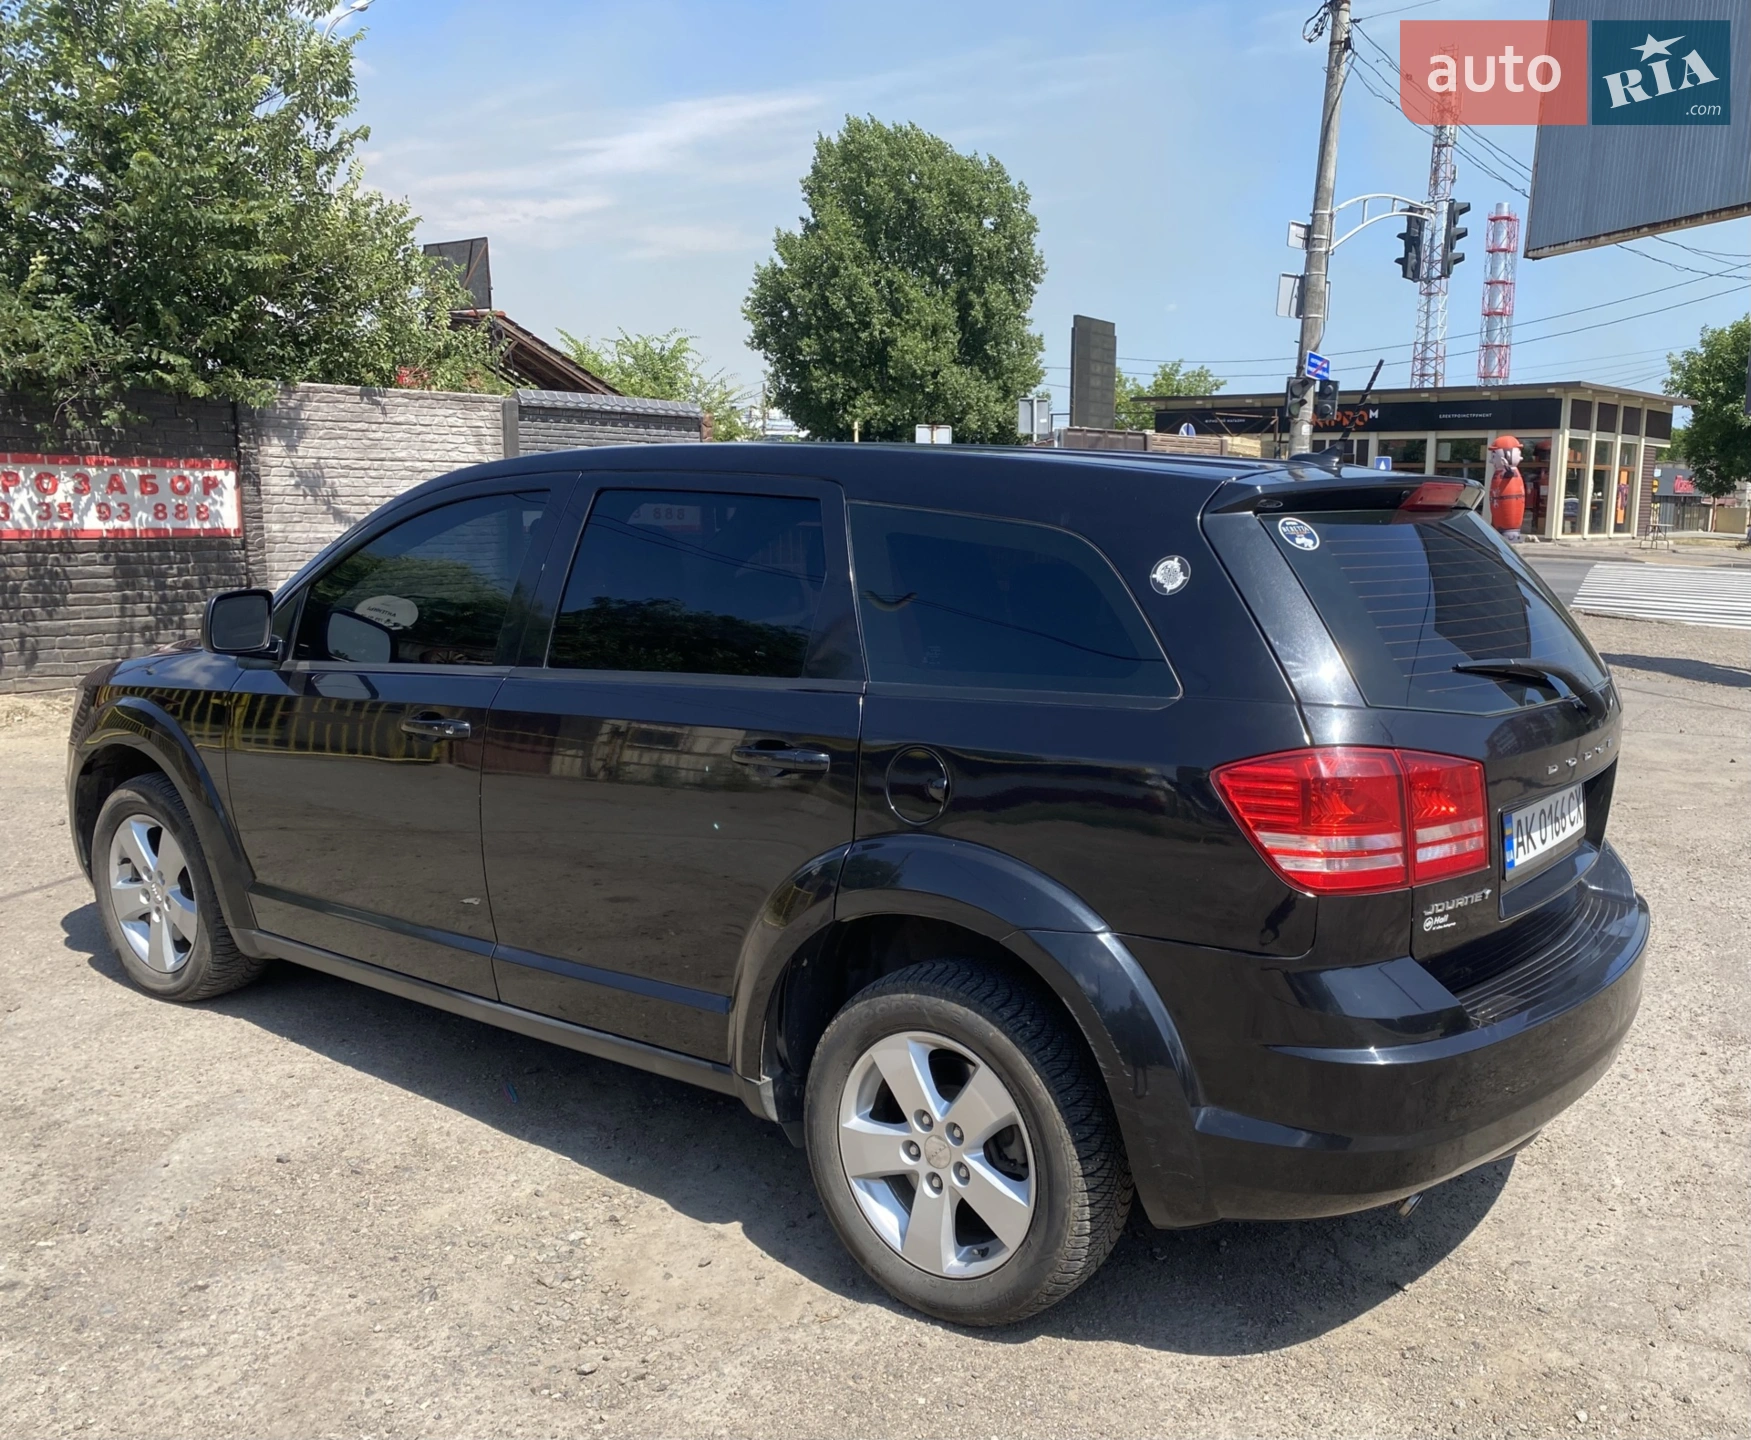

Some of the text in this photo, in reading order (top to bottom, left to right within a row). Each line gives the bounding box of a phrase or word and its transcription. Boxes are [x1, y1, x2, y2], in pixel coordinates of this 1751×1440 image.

[37, 502, 74, 521] 35
[96, 502, 131, 522] 93
[153, 502, 210, 522] 888
[1515, 786, 1583, 860] AK 0166 CX
[1423, 888, 1492, 916] JOURNEY
